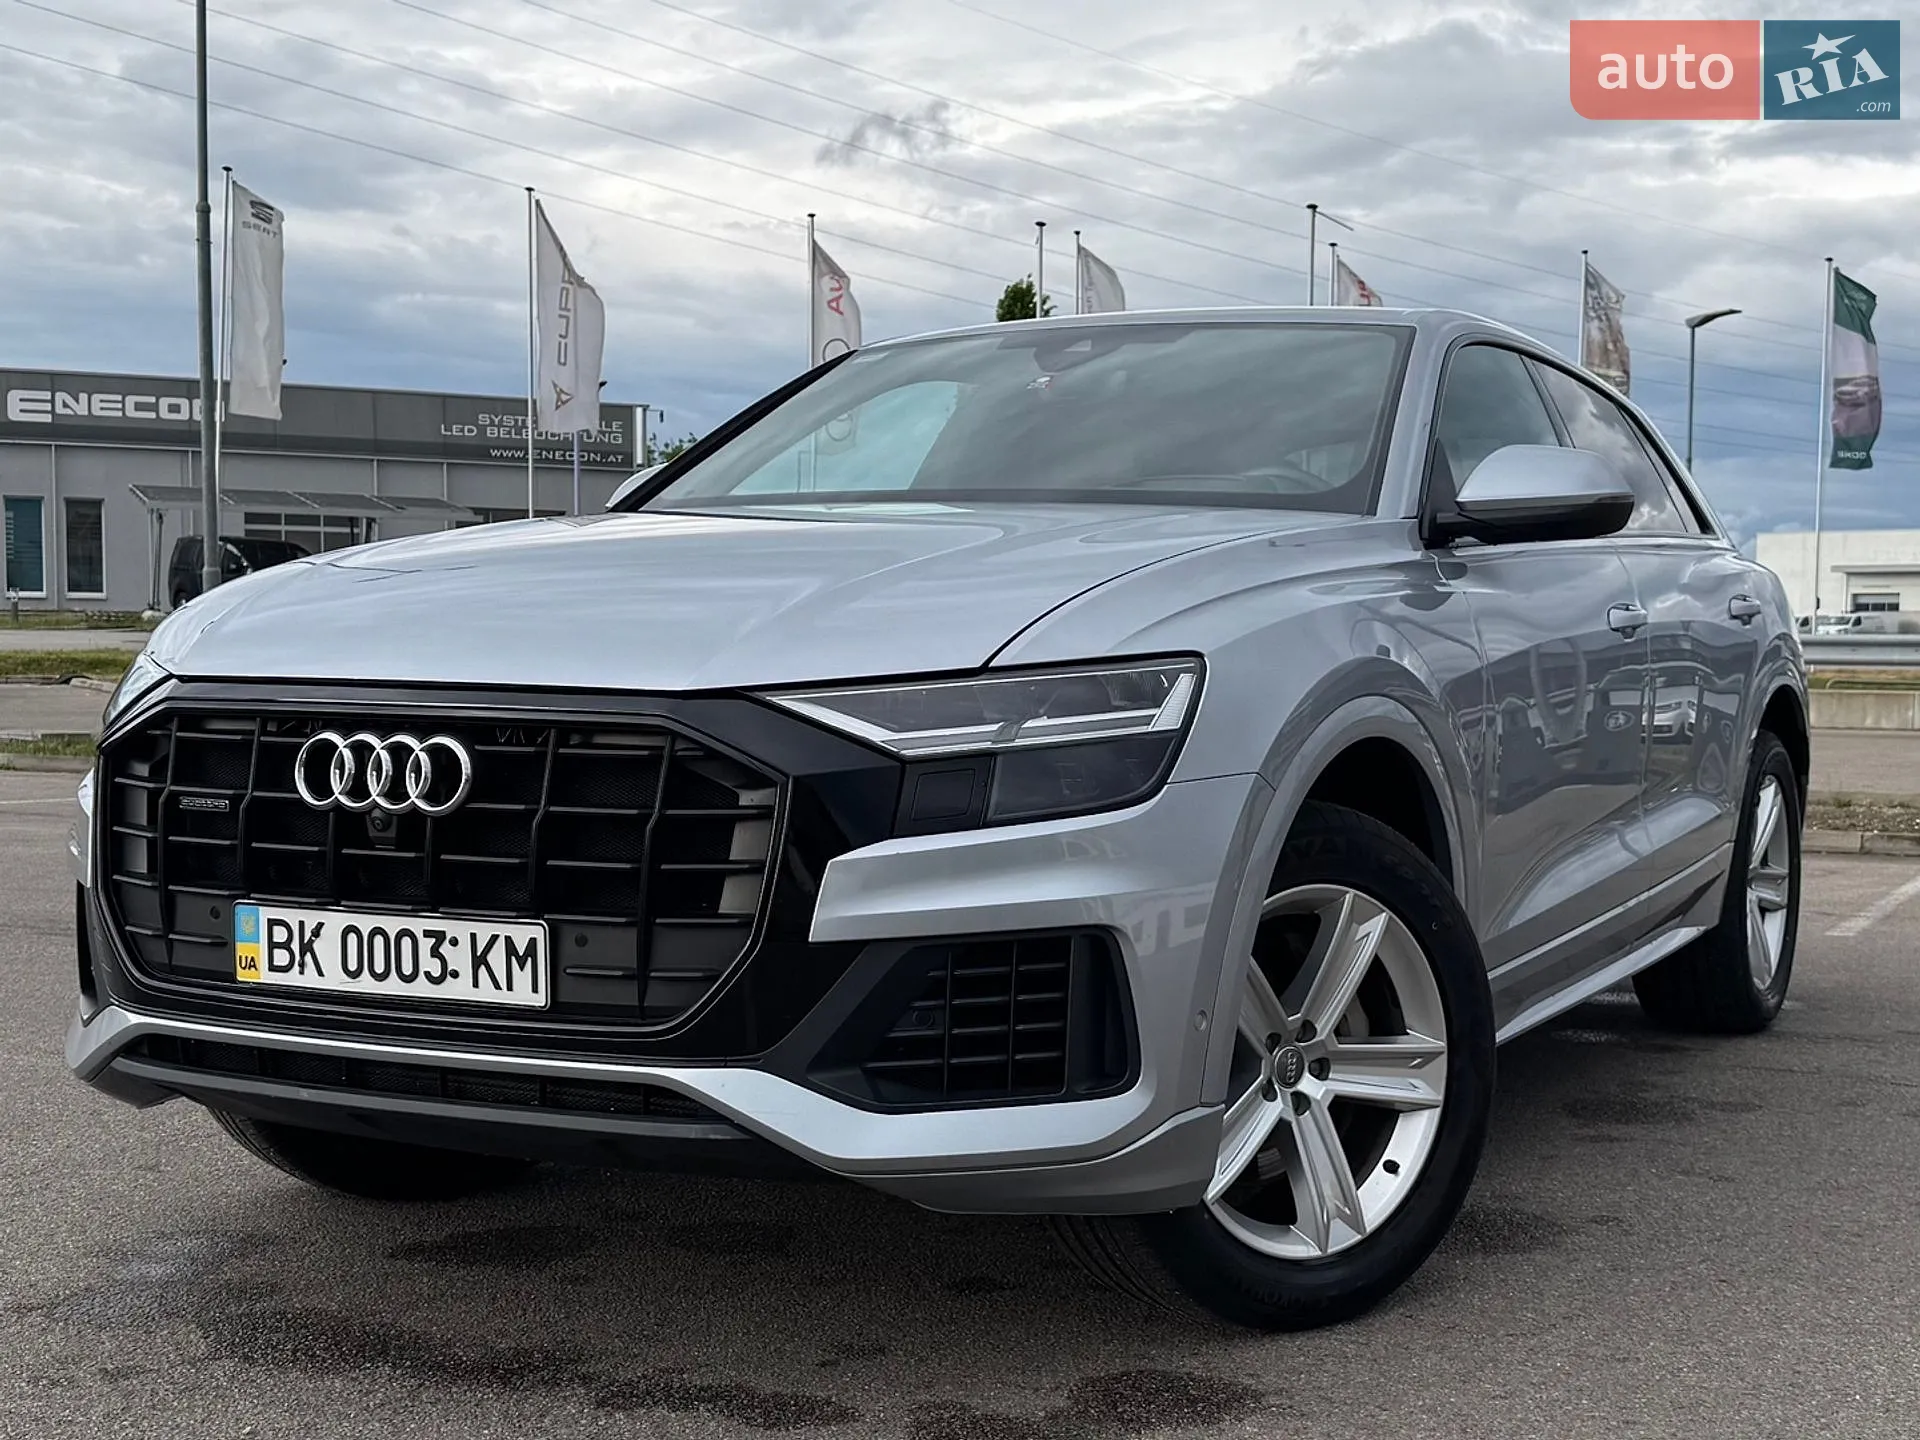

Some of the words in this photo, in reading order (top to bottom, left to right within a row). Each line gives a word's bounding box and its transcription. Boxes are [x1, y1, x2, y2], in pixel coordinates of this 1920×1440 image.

[827, 275, 844, 316] AU
[441, 423, 477, 436] LED
[486, 426, 623, 444] BELEUCHUNG
[238, 955, 258, 971] UA
[266, 918, 325, 977] BK
[469, 931, 539, 994] KM
